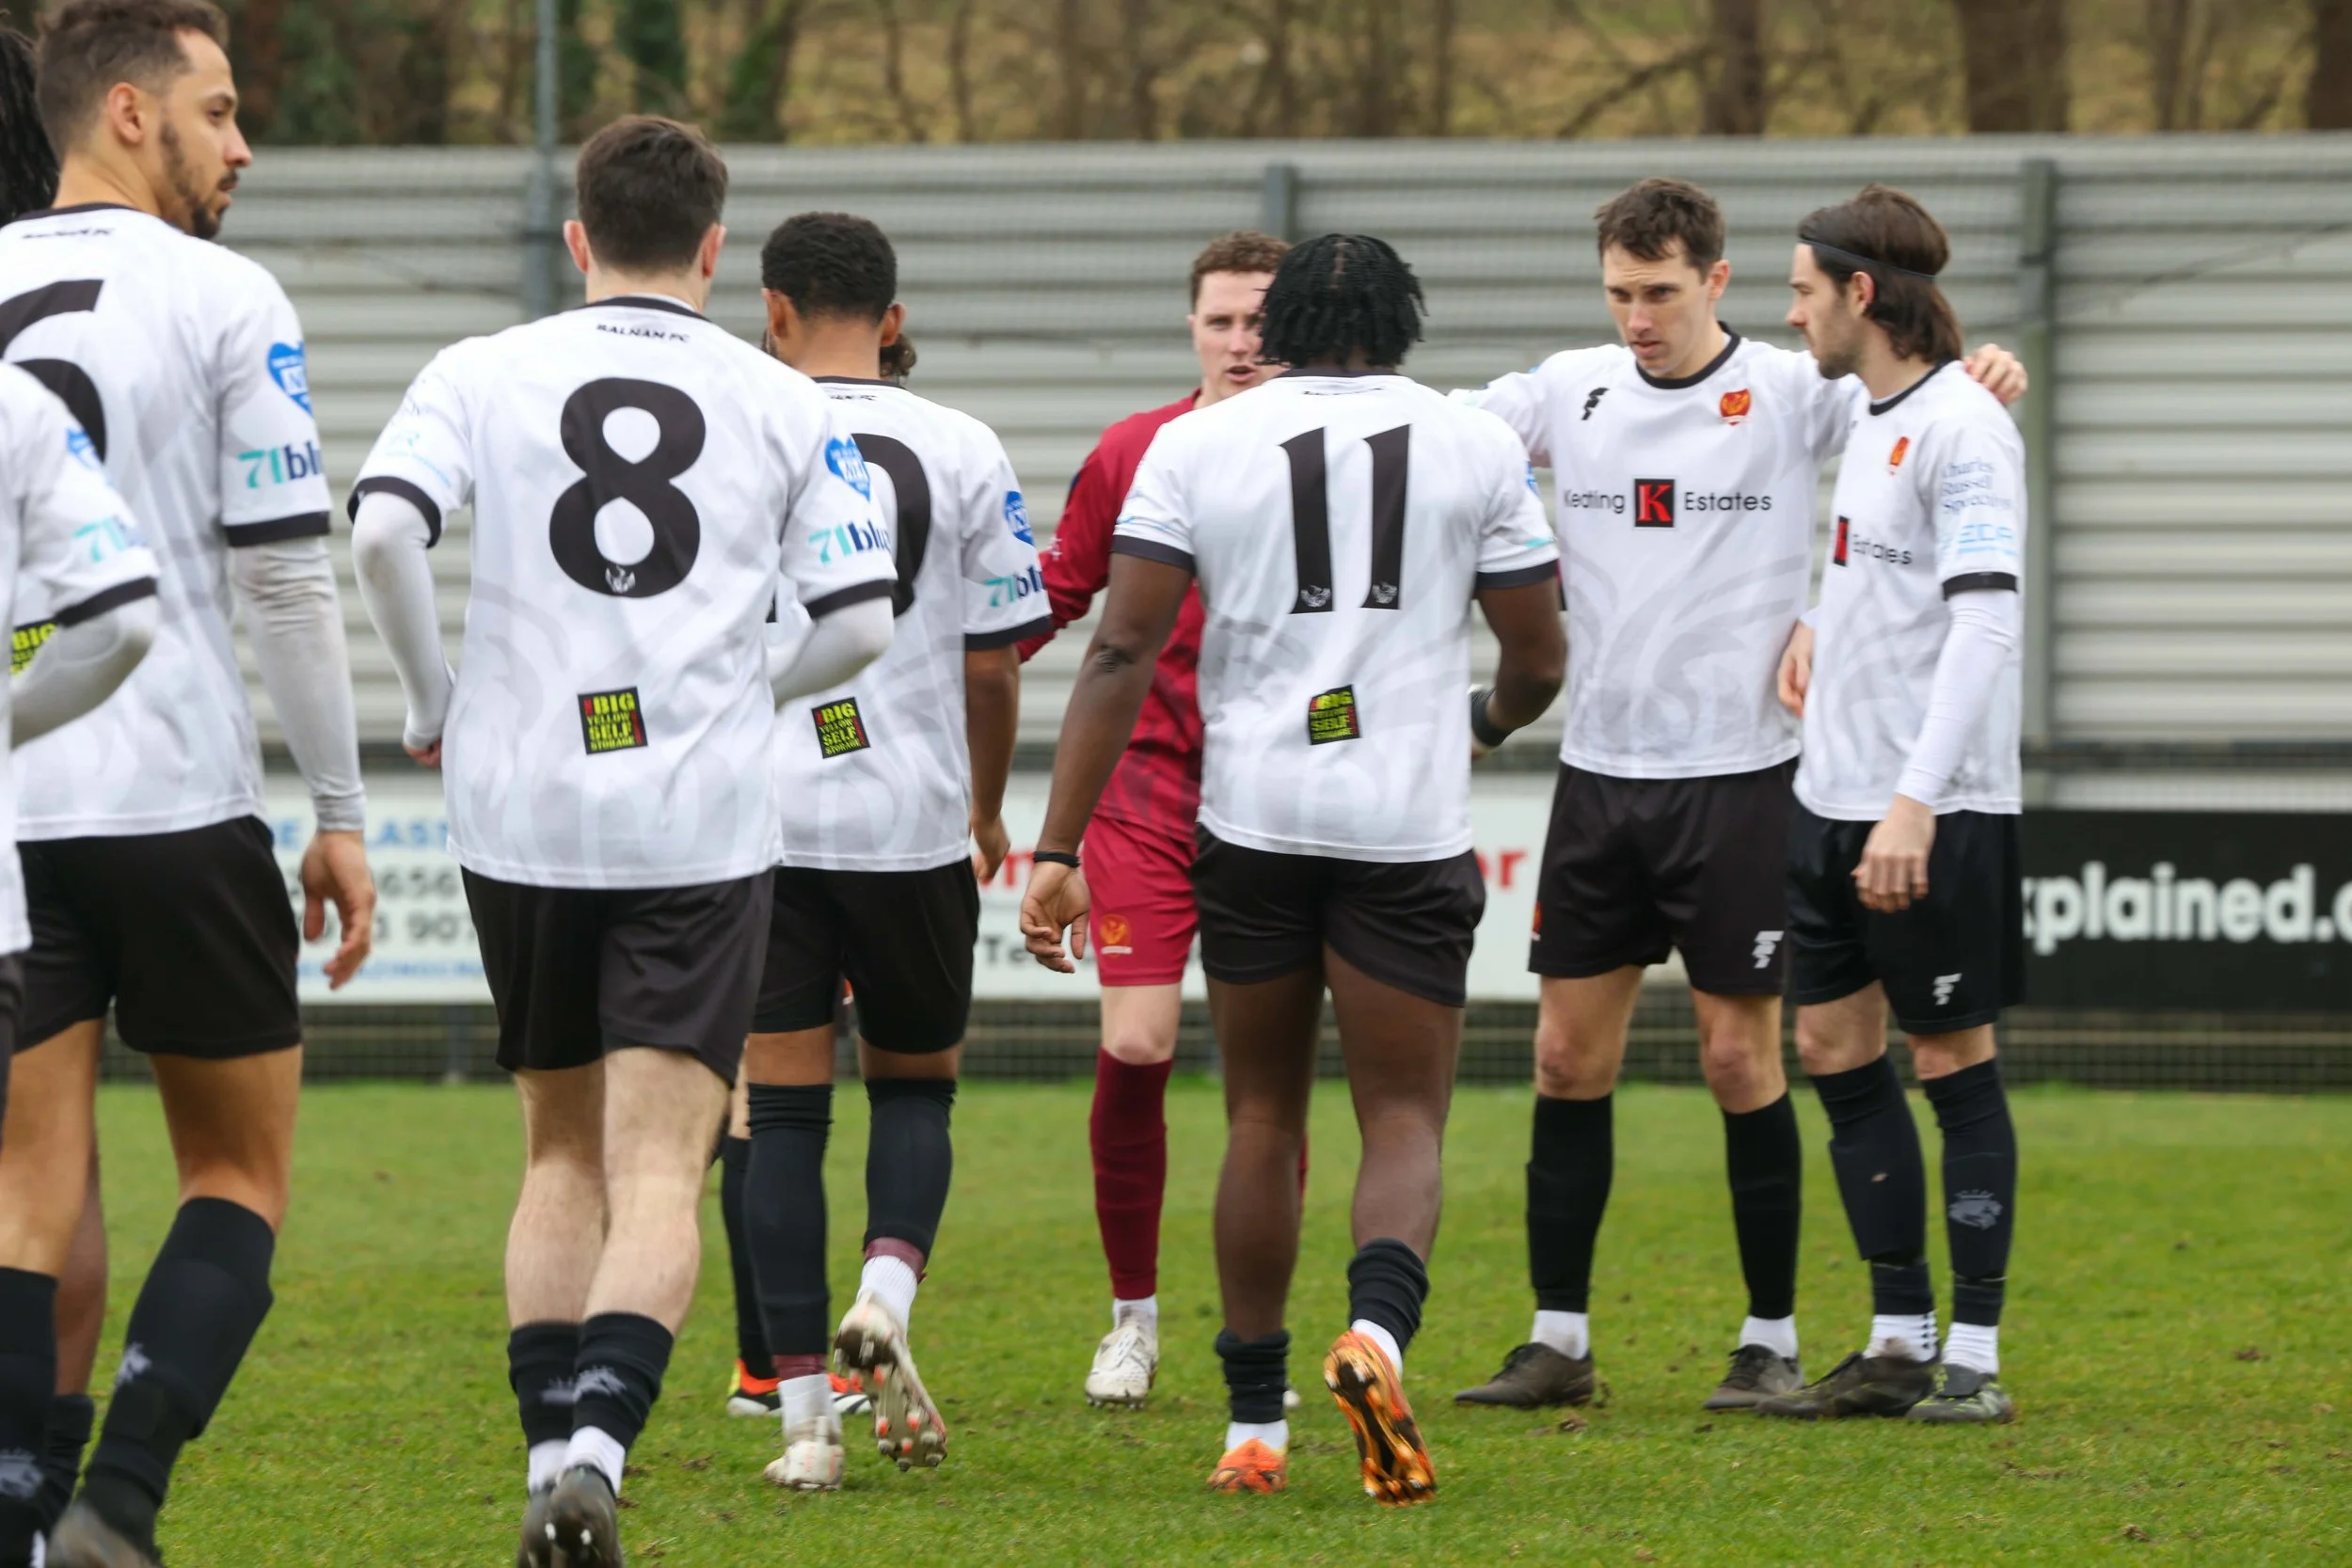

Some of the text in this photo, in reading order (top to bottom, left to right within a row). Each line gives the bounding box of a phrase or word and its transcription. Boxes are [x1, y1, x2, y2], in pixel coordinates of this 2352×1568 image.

[549, 376, 706, 599] 8
[1563, 483, 1773, 523] Keating K Estates
[1276, 423, 1411, 615] 11
[593, 691, 636, 716] BIG
[821, 702, 856, 723] BIG
[586, 711, 630, 725] YELLOW
[589, 721, 632, 741] SELF
[822, 727, 856, 746] SELF
[591, 735, 635, 752] STORAGE
